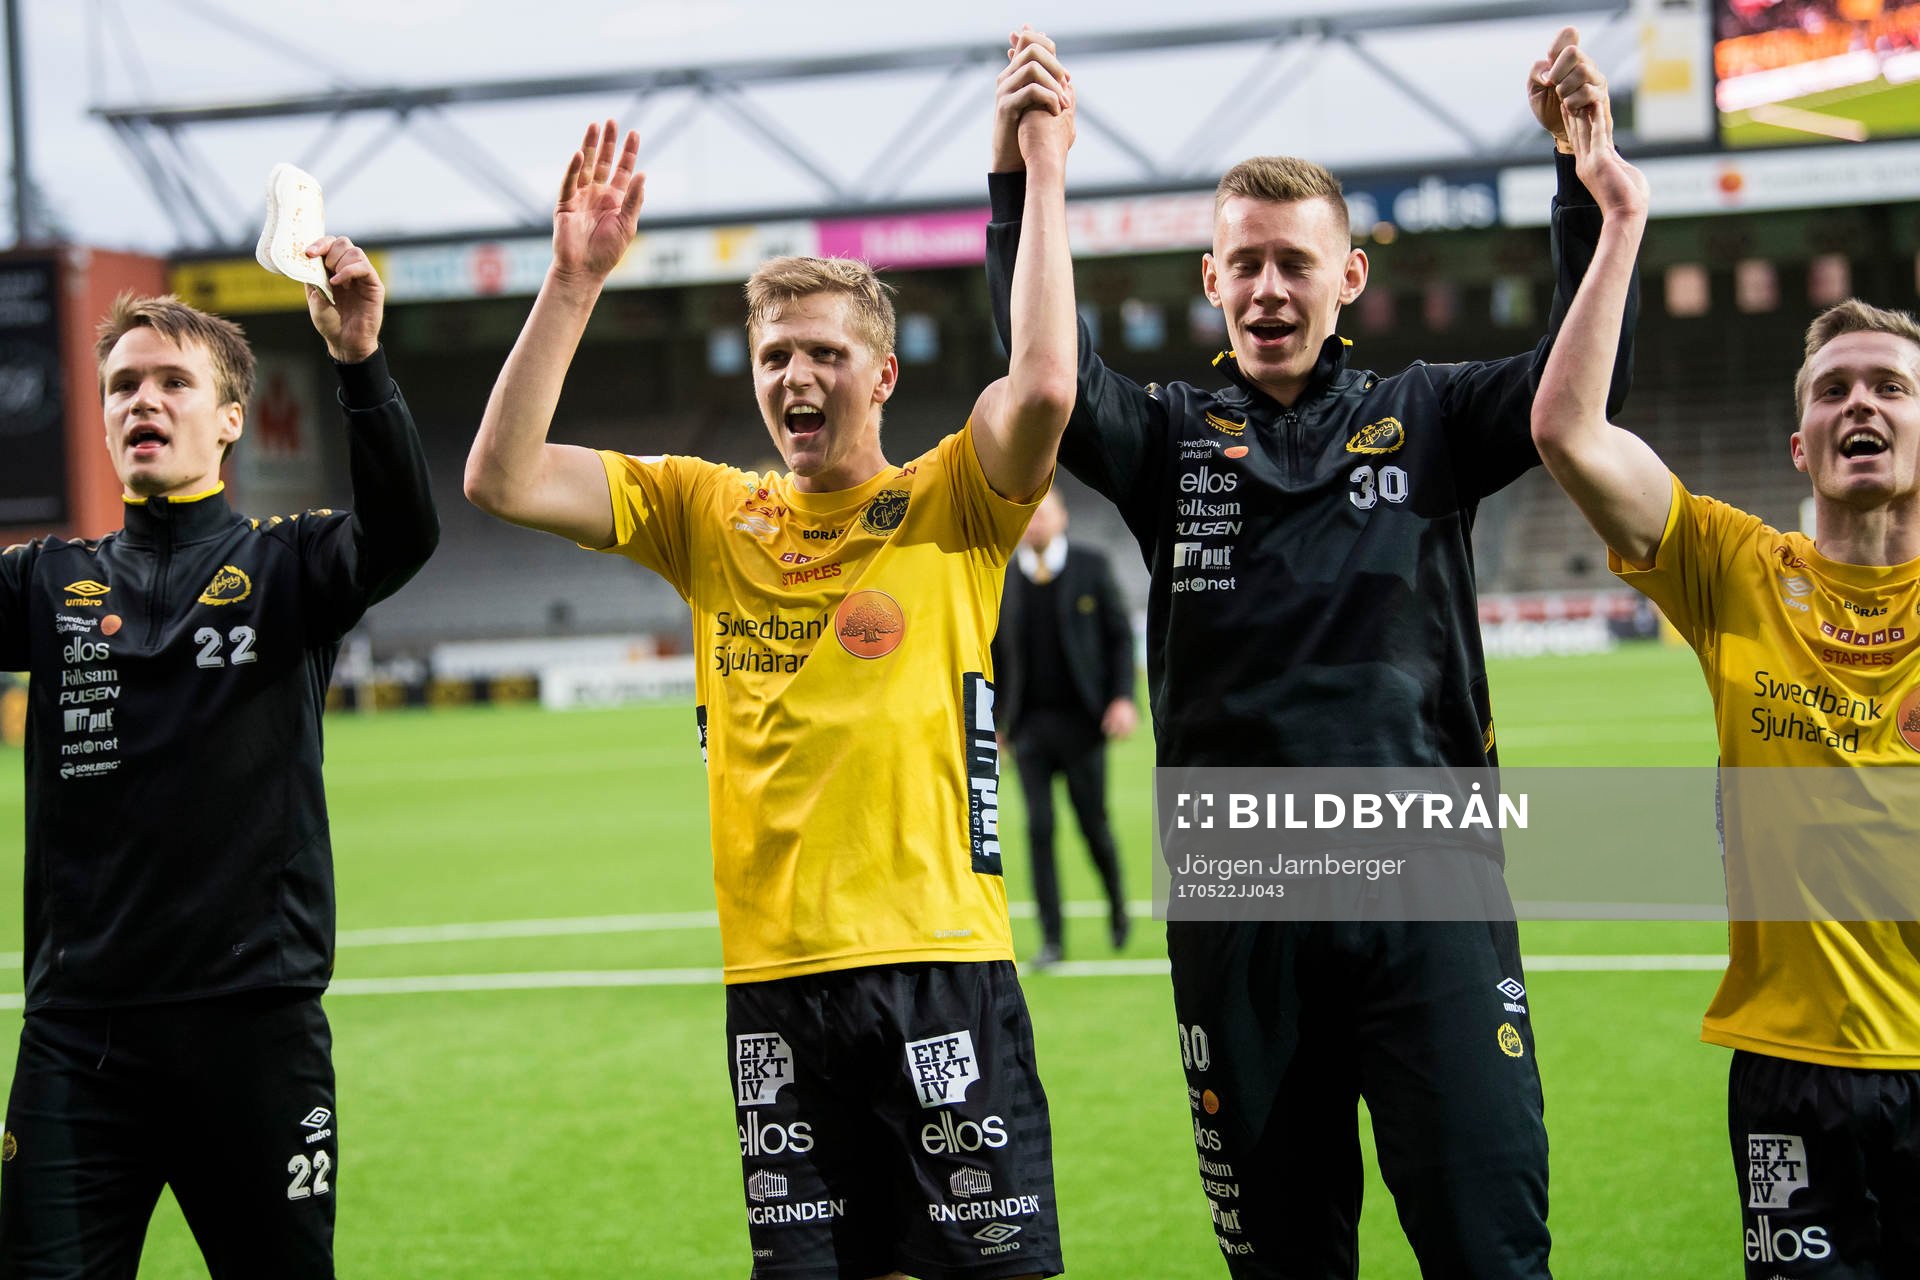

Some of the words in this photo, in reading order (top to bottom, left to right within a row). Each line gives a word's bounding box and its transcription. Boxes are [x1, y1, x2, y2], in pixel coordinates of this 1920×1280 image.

[1180, 466, 1238, 493] ellos
[1349, 465, 1409, 510] 30
[782, 561, 842, 587] STAPLES
[65, 598, 103, 607] umbro
[55, 613, 98, 627] Swedbank
[1822, 624, 1902, 645] CRAMO
[63, 636, 110, 664] ellos
[194, 625, 258, 669] 22
[1822, 649, 1895, 666] STAPLES
[62, 669, 118, 687] Folksam
[59, 686, 121, 705] PULSEN
[1754, 671, 1883, 721] Swedbank
[1751, 707, 1859, 754] Sjuhärad
[740, 1037, 780, 1059] EFF
[911, 1037, 960, 1066] EFF
[740, 1058, 788, 1080] EKT
[916, 1056, 971, 1082] EKT
[741, 1080, 764, 1101] IV
[921, 1080, 950, 1103] IV
[306, 1128, 331, 1144] umbro
[921, 1110, 1008, 1155] ellos
[1750, 1139, 1793, 1160] EFF
[287, 1150, 332, 1200] 22
[1751, 1160, 1801, 1182] EKT
[1753, 1182, 1775, 1203] IV
[980, 1240, 1021, 1256] umbro
[1745, 1214, 1832, 1263] ellos
